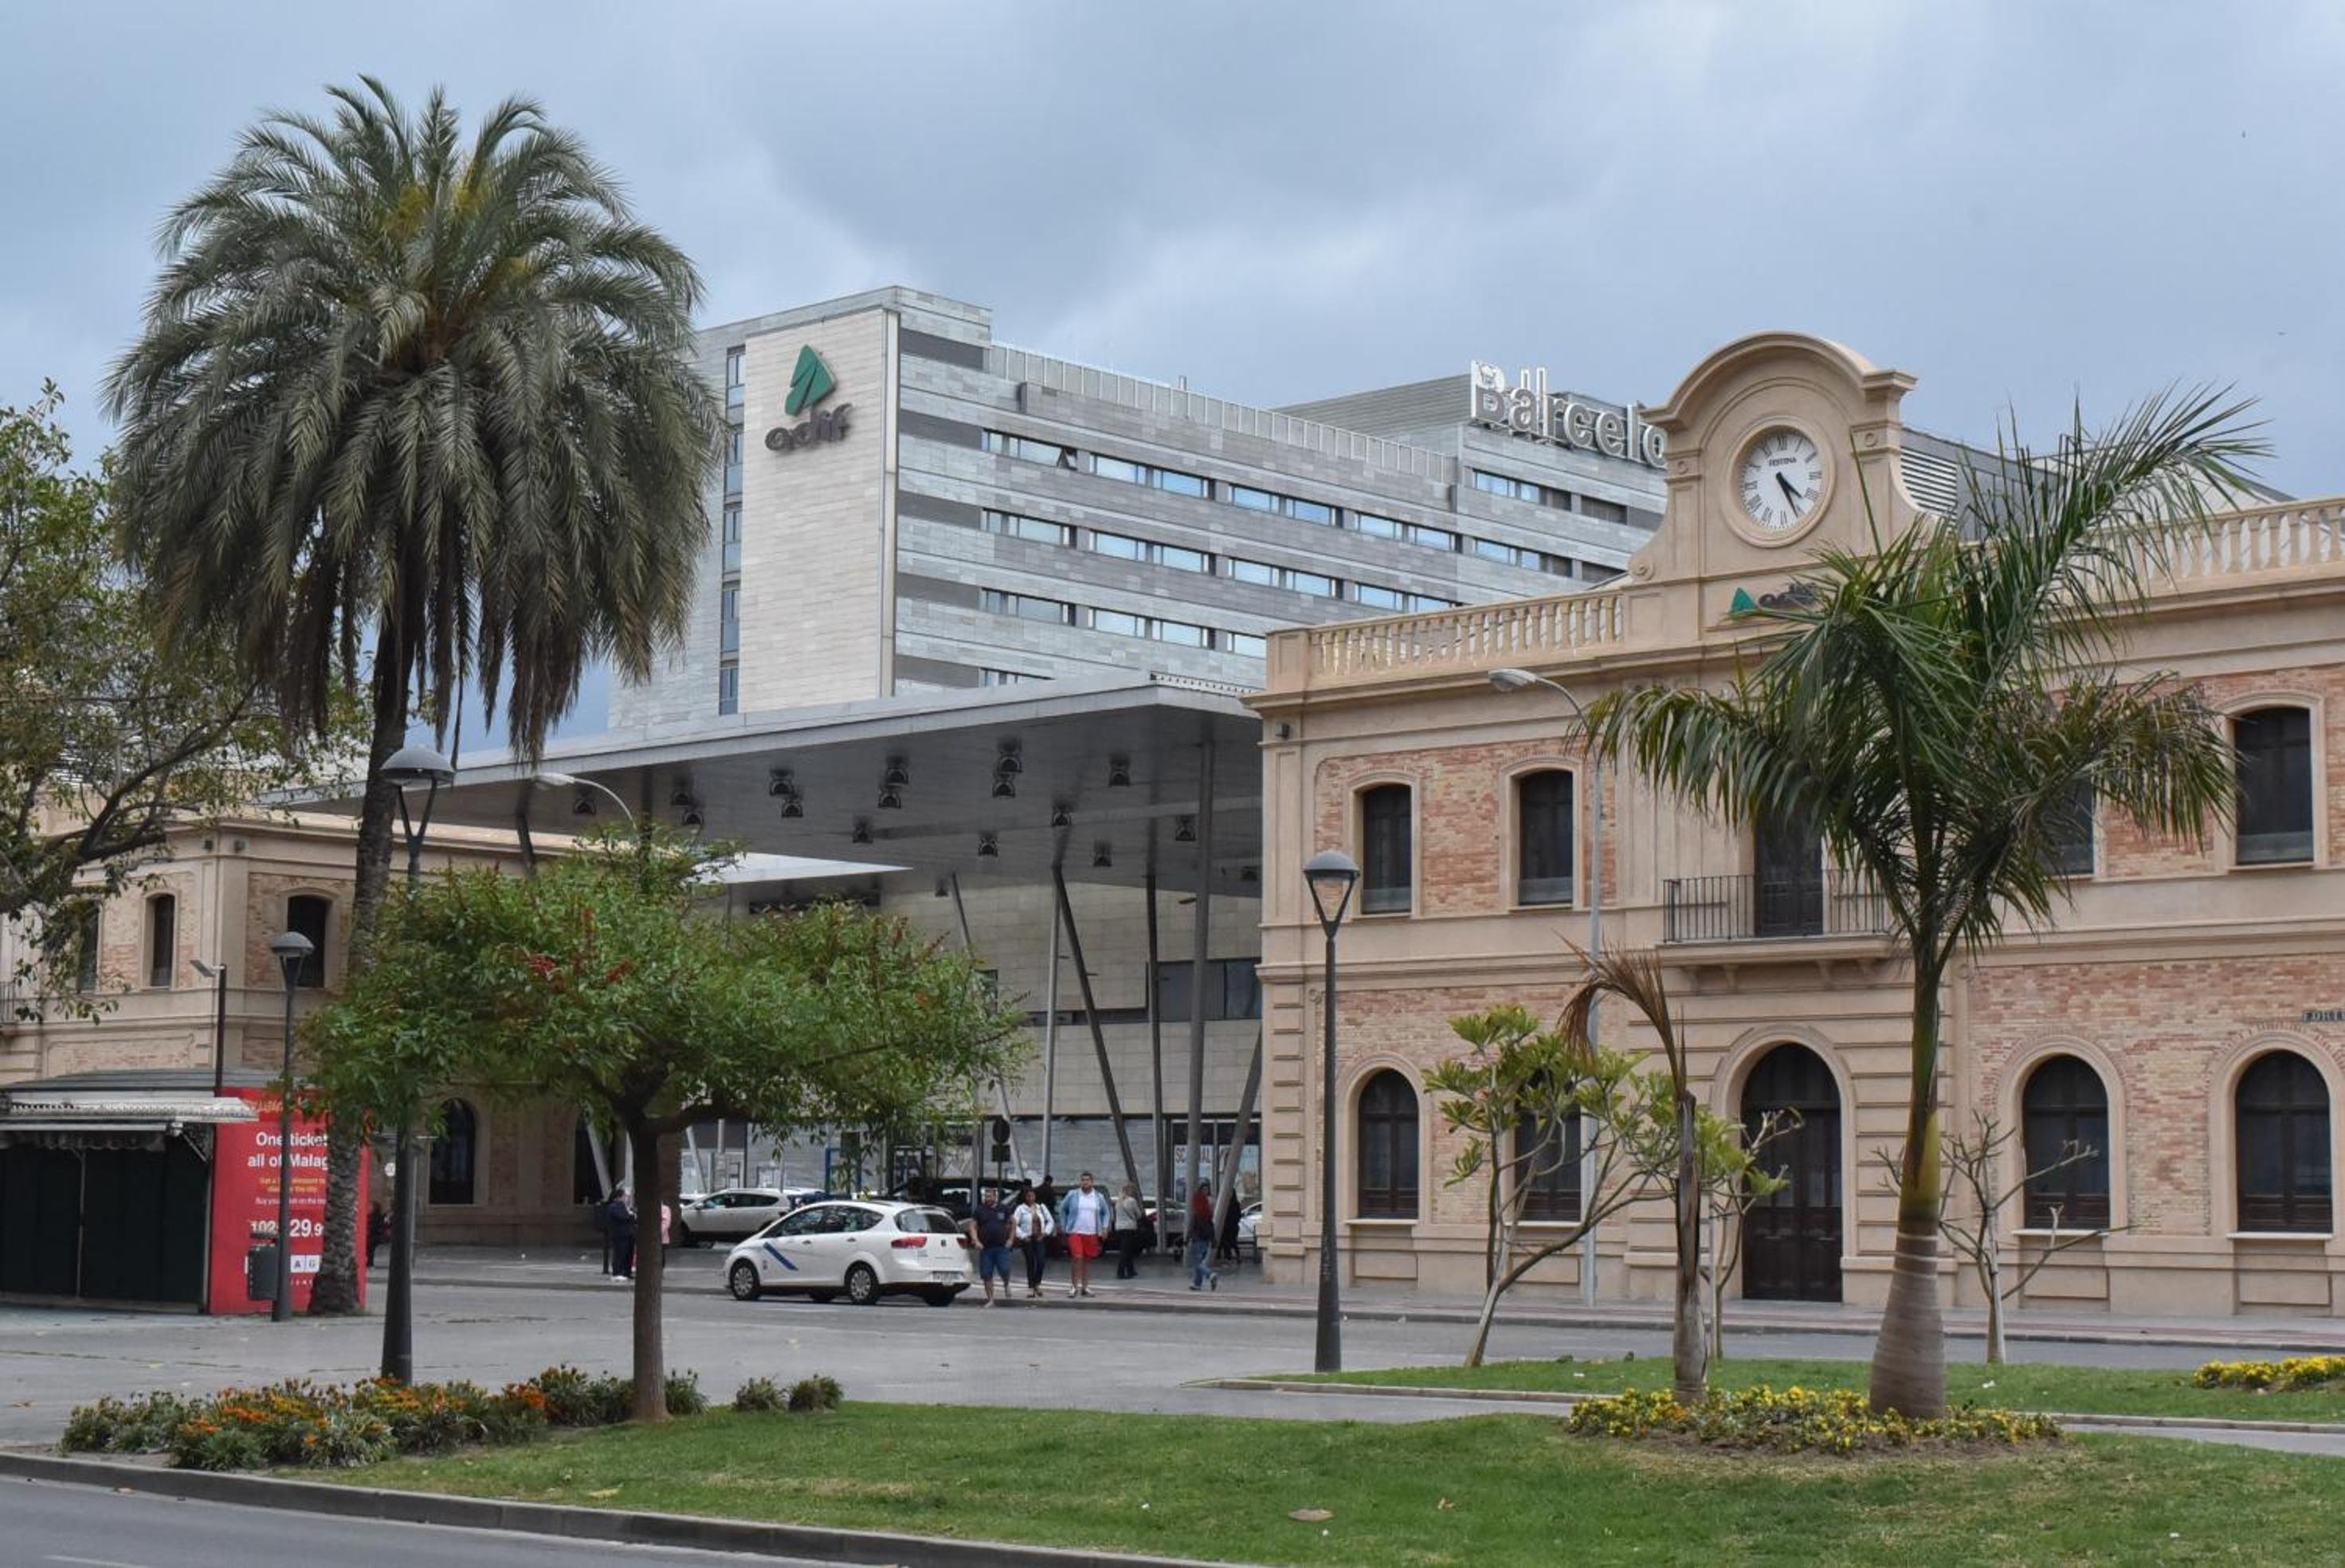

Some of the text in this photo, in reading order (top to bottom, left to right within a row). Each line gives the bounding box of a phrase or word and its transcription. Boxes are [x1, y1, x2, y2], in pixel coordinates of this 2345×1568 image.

[764, 402, 853, 451] adif
[256, 1131, 282, 1147] One
[248, 1153, 265, 1167] all
[290, 1154, 328, 1171] Malag
